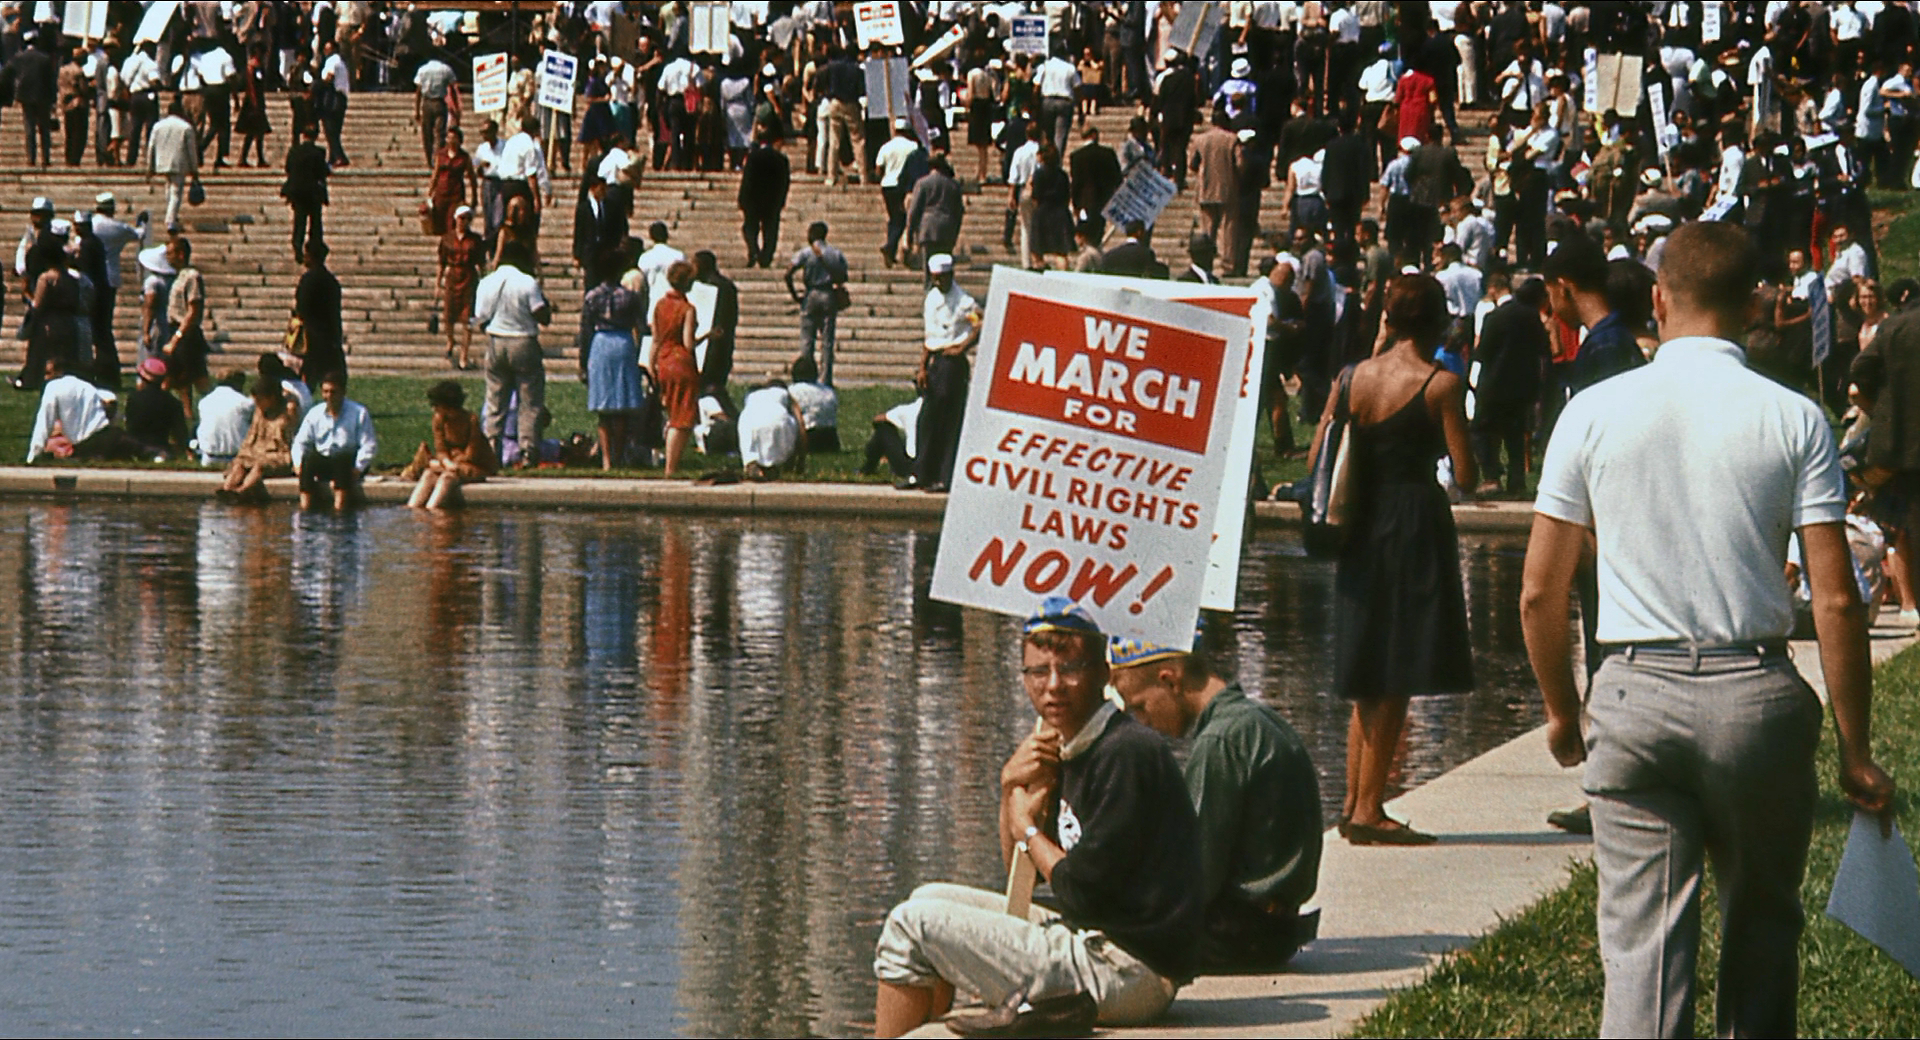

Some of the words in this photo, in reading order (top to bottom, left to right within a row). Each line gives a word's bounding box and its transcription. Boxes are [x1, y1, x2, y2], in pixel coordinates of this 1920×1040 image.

[1084, 316, 1149, 361] WE
[1009, 342, 1200, 419] MARCH
[1064, 398, 1137, 433] FOR
[997, 428, 1193, 492] EFFECTIVE
[965, 455, 1057, 500] CIVIL
[1067, 477, 1200, 530] RIGHTS
[1020, 502, 1129, 550] LAWS
[968, 536, 1174, 615] NOW!
